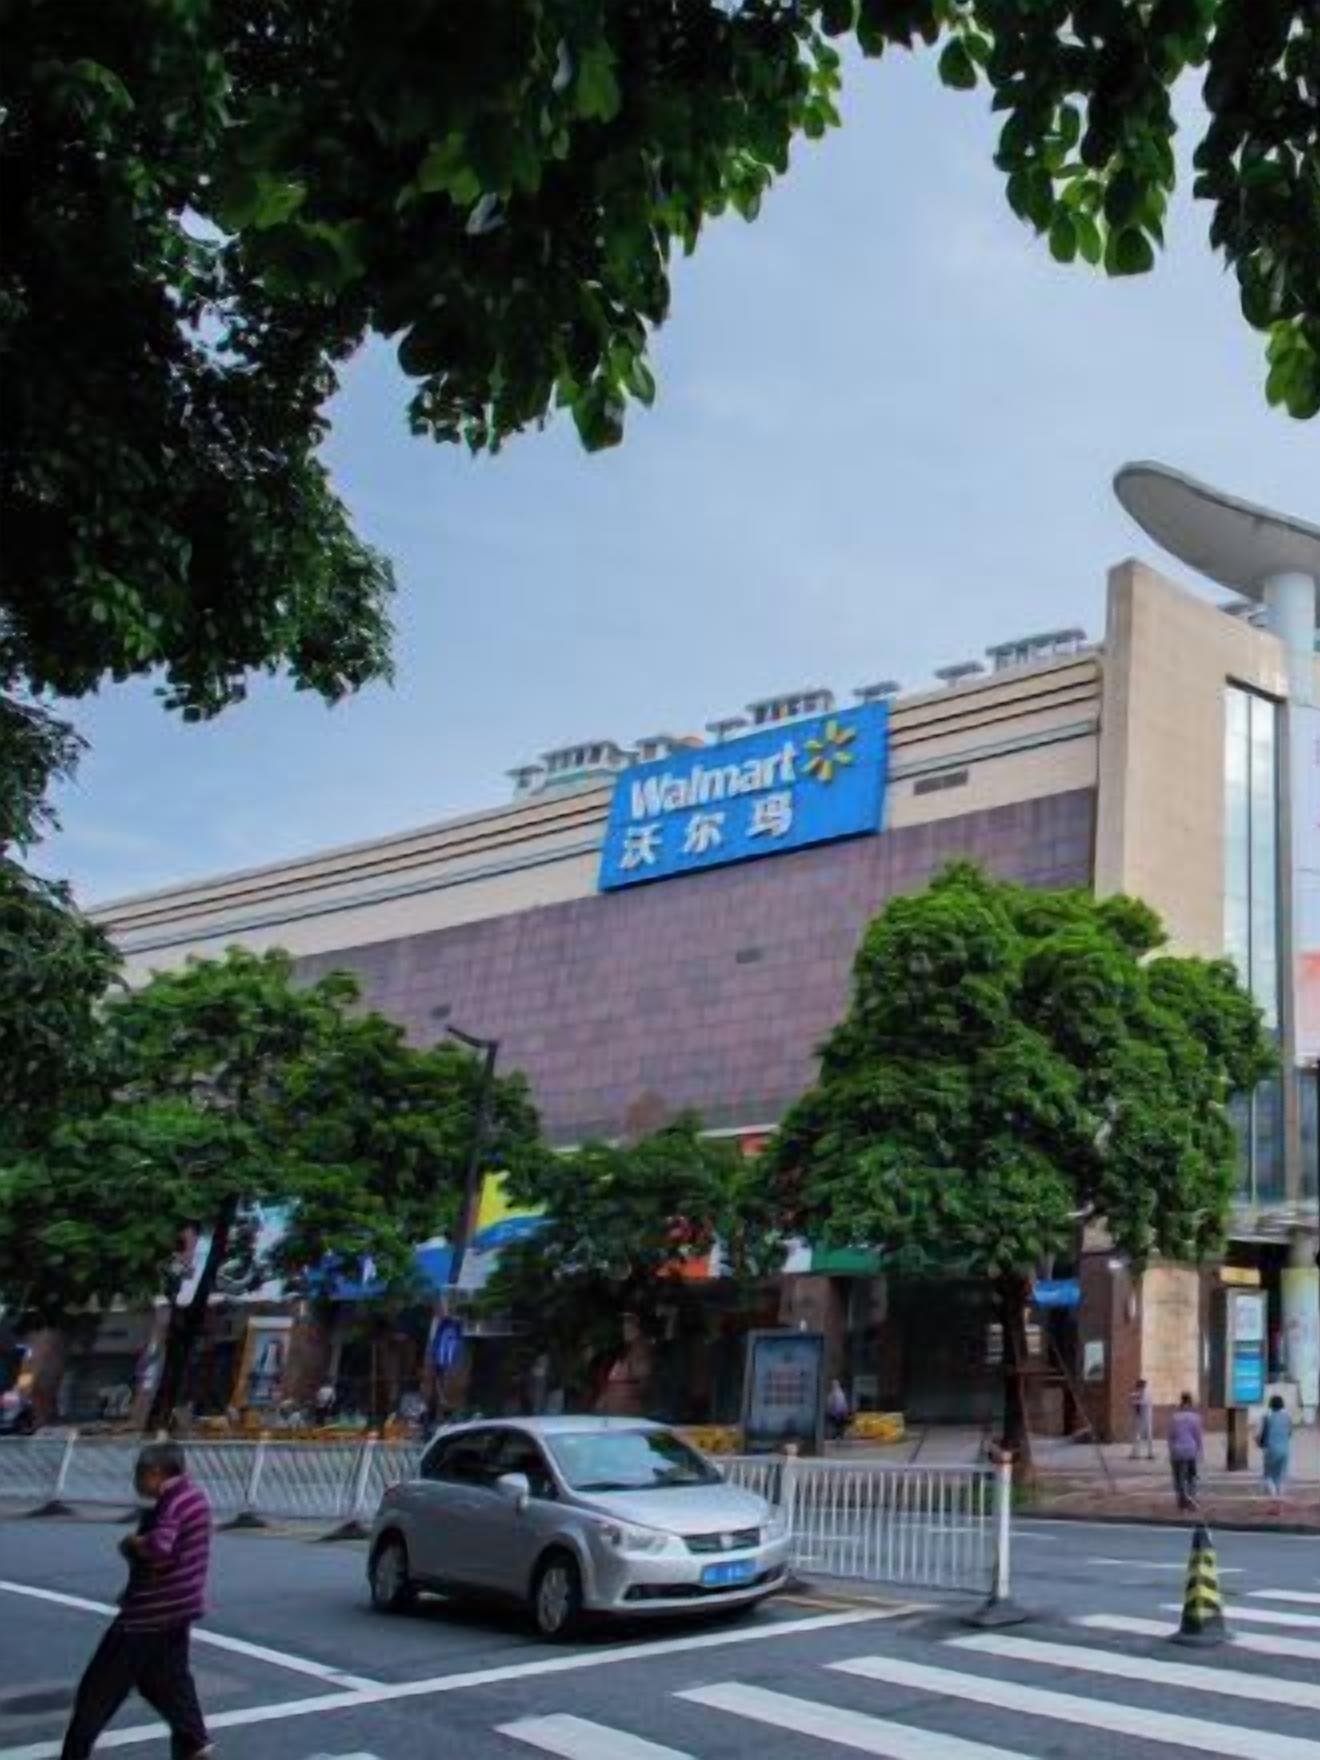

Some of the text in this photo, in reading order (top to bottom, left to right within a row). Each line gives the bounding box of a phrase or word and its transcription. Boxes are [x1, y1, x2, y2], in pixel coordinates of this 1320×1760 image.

[631, 741, 796, 819] Walmart
[619, 792, 793, 869] 沃尔玛
